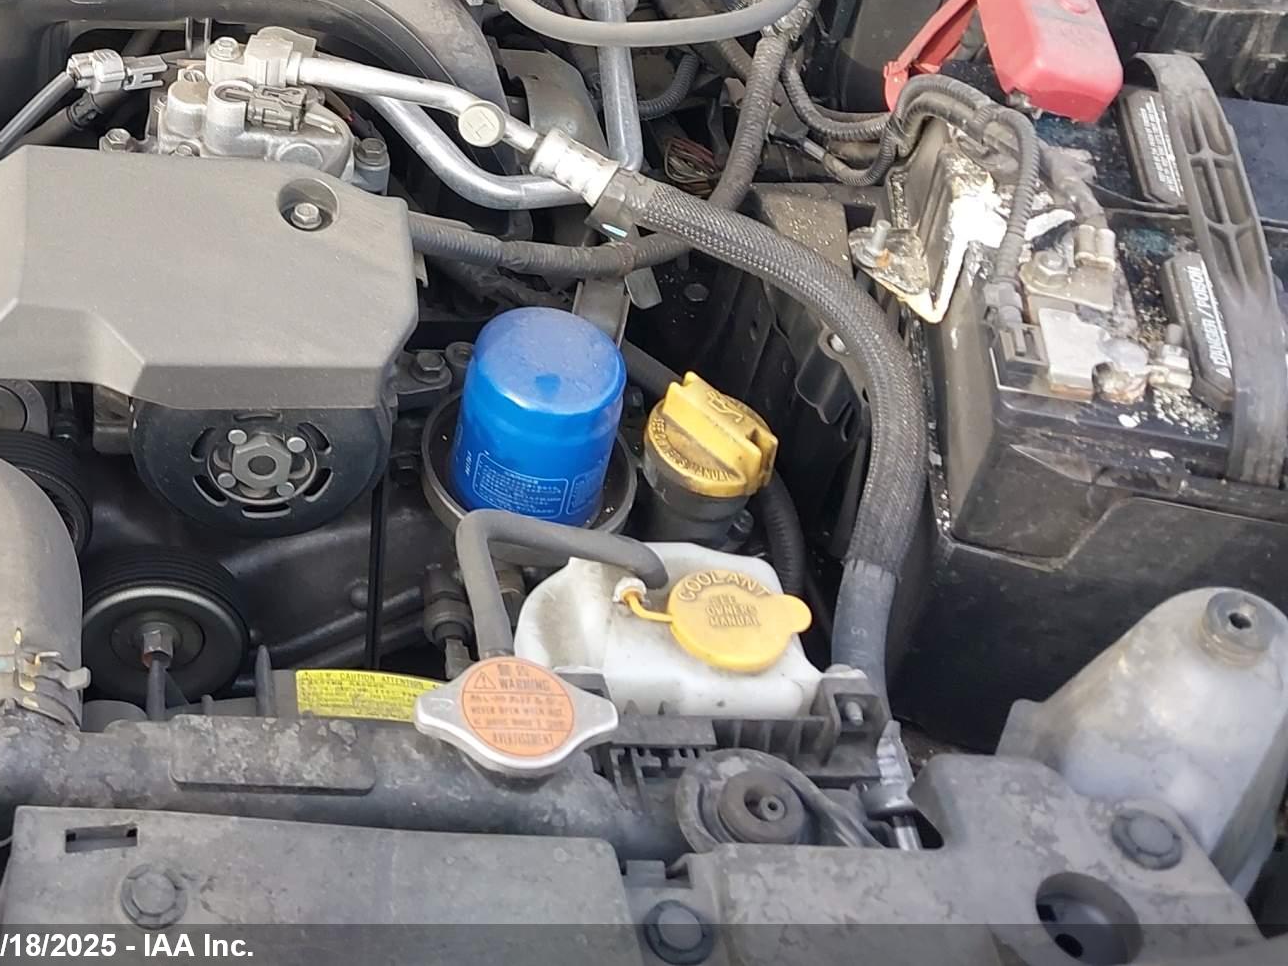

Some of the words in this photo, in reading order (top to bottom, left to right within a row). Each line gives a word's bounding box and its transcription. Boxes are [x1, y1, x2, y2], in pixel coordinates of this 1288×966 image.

[678, 570, 772, 601] COOLANT
[708, 615, 762, 627] MANUAL
[339, 672, 376, 682] CAUTION
